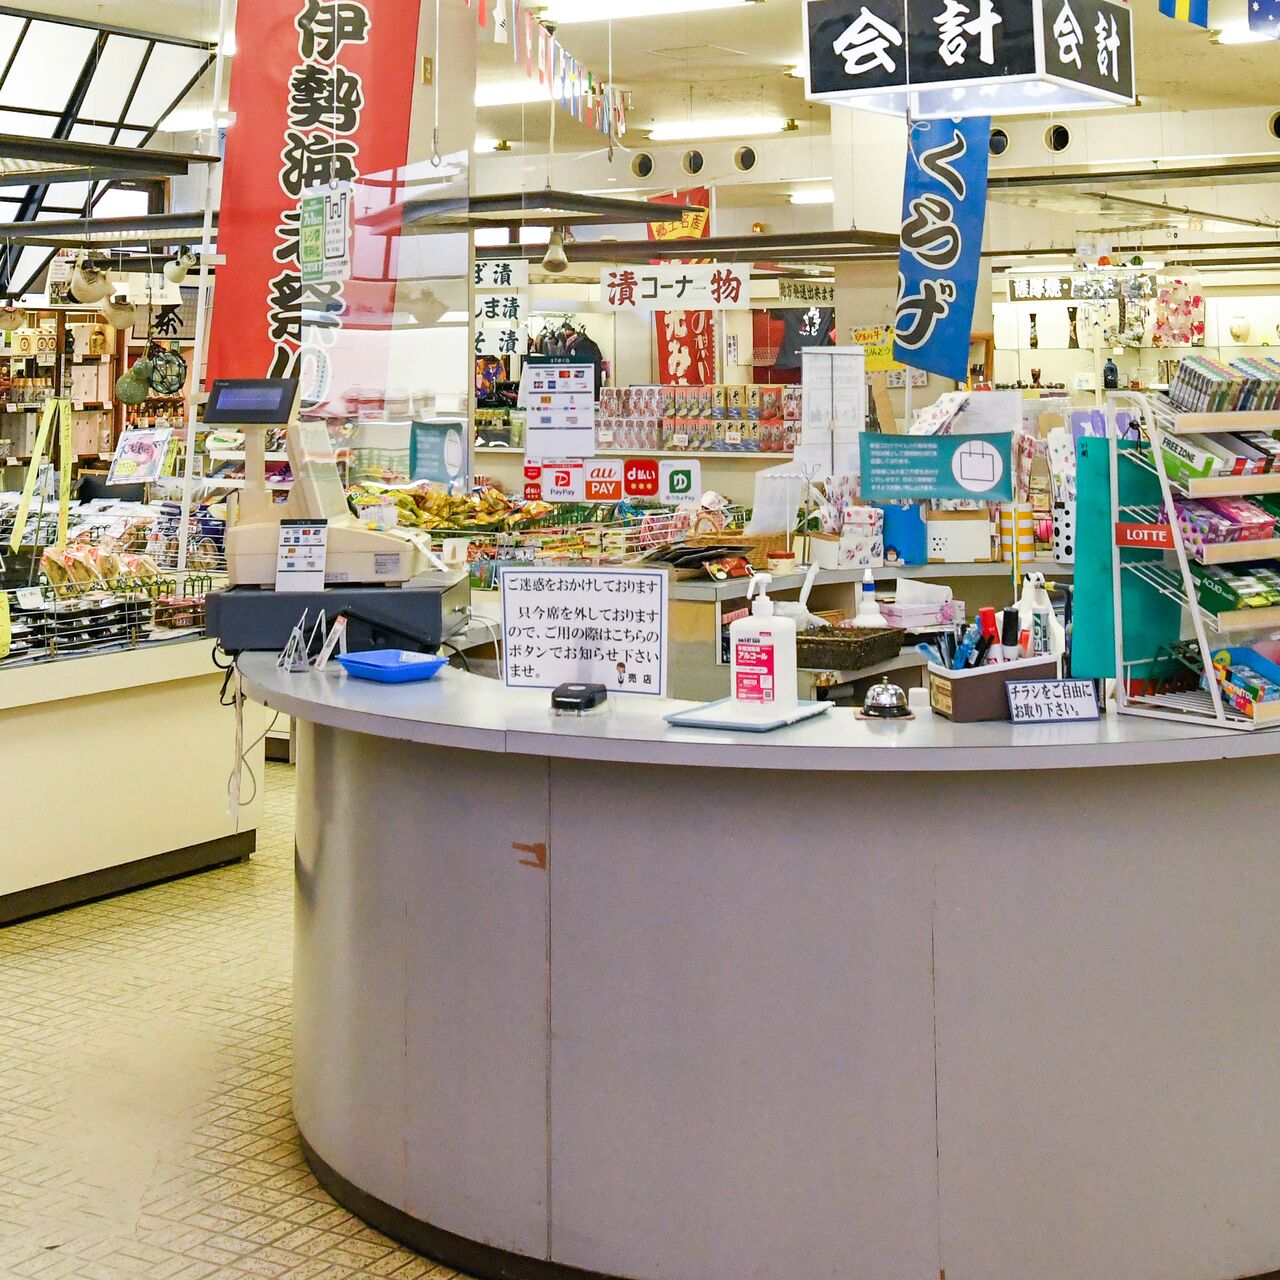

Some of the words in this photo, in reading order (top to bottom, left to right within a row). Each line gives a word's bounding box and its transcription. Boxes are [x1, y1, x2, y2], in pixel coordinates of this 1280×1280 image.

[590, 467, 616, 479] au
[626, 467, 656, 481] d払い
[550, 488, 575, 497] PayPay
[591, 483, 616, 495] PAY
[1126, 529, 1167, 543] LOTTE
[507, 577, 659, 595] ご迷惑をおかけしております
[518, 606, 660, 623] 只今席を外しております
[508, 625, 660, 644] ので、ご用の際はこちらの
[509, 645, 660, 664] ボタンでお知らせ下さい
[738, 652, 769, 660] アルコール
[509, 664, 541, 679] ませ。
[627, 673, 653, 686] 売店
[1010, 682, 1093, 703] チラシをご自由に
[1013, 699, 1082, 719] お取り下さい。
